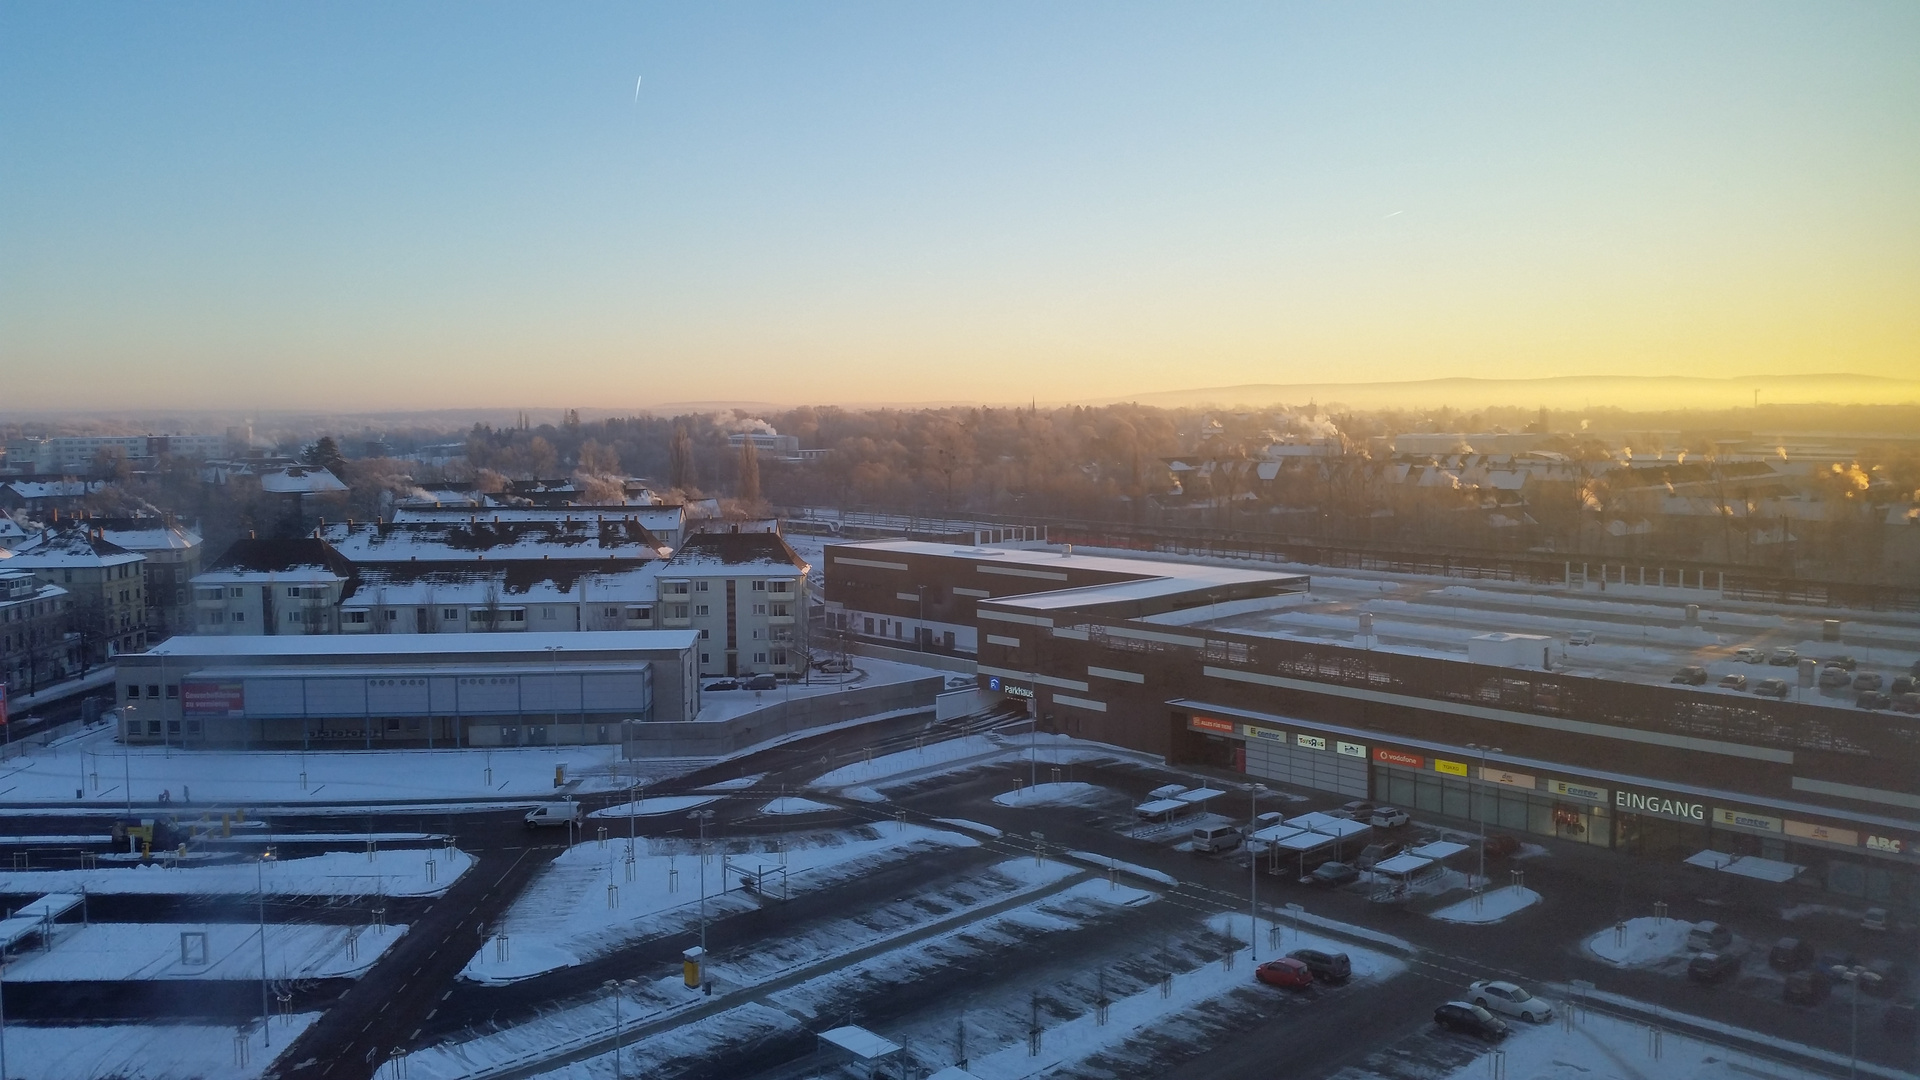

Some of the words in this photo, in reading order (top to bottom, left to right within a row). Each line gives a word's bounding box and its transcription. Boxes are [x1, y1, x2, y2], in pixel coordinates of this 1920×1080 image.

[1004, 685, 1033, 698] Parkhaus
[1257, 730, 1279, 740] center
[1388, 754, 1417, 765] vodafone
[1567, 787, 1598, 798] center
[1616, 790, 1704, 820] EINGANG
[1735, 816, 1770, 828] center
[1814, 826, 1827, 835] dm
[1866, 835, 1900, 851] ABC
